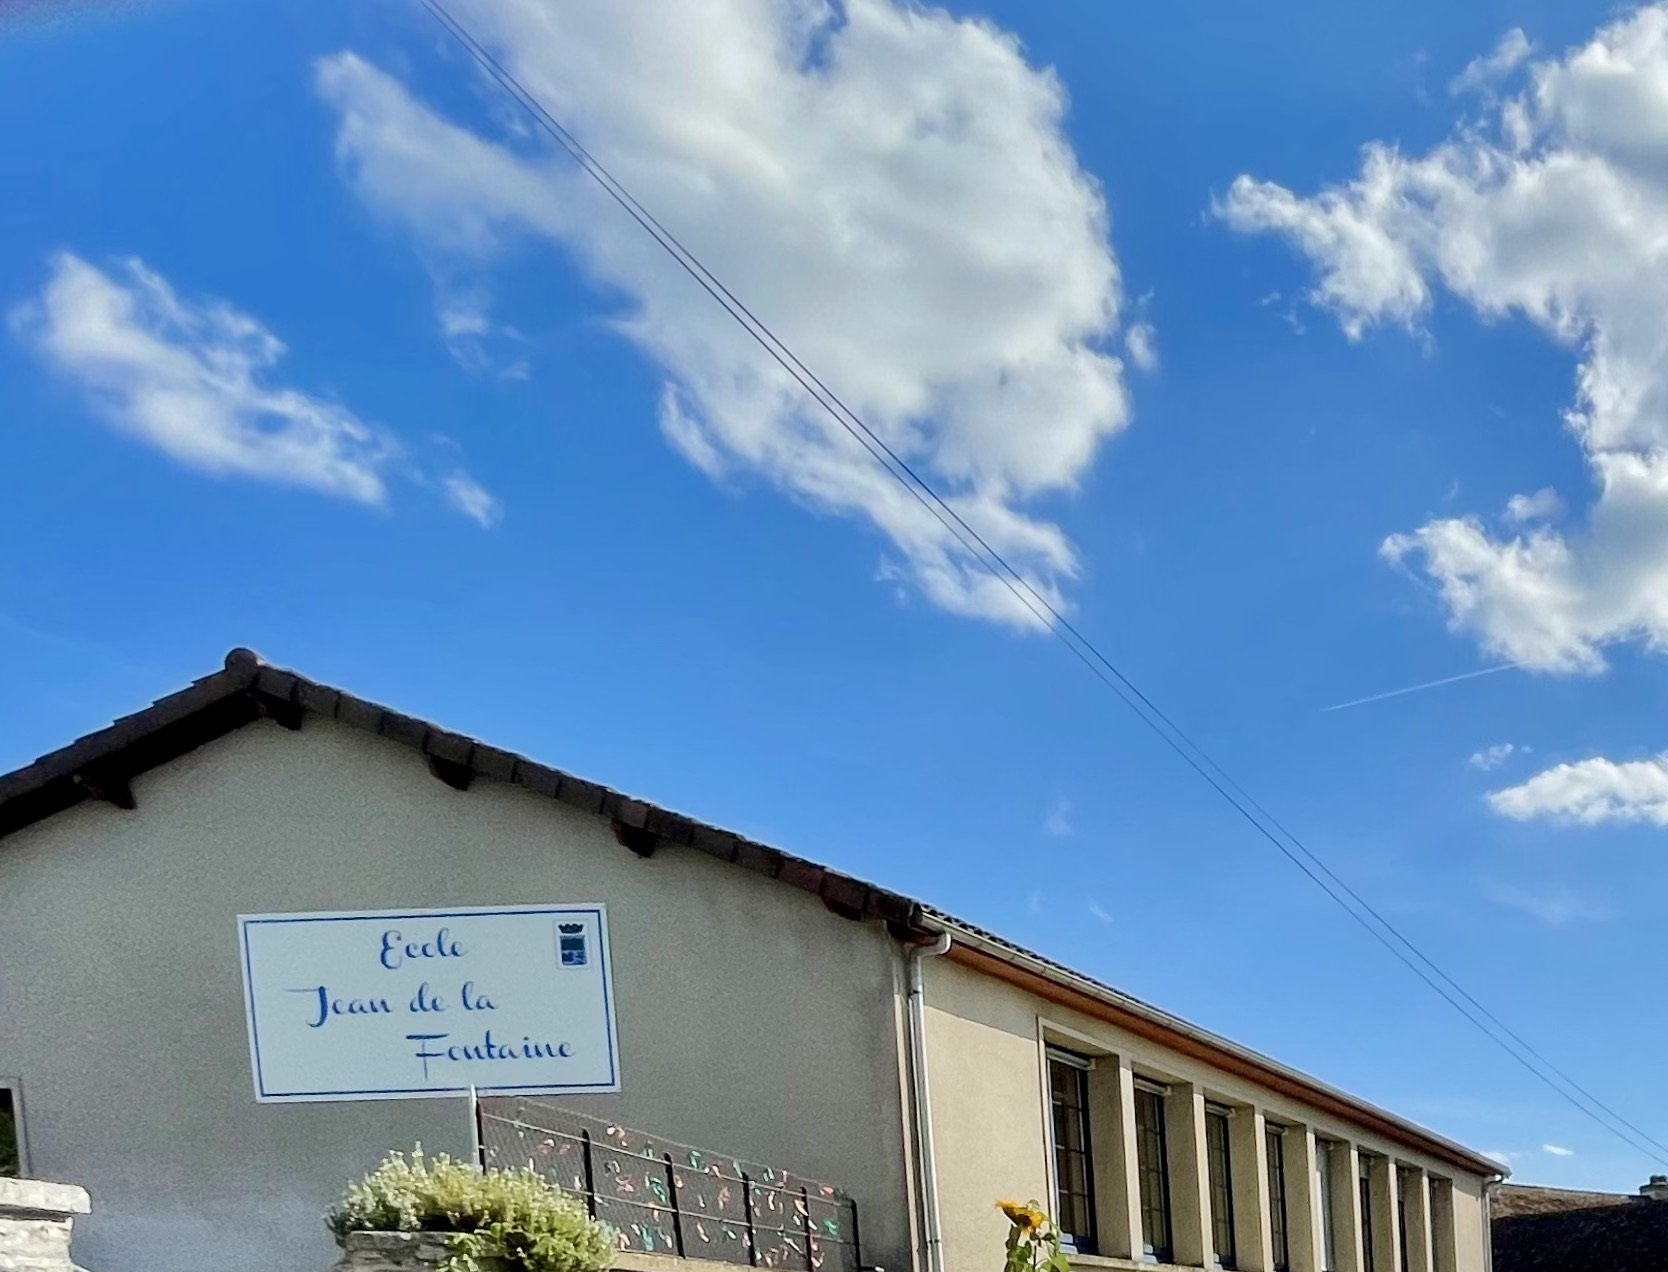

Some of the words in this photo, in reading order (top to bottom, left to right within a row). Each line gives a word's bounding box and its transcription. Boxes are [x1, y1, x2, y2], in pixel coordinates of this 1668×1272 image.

[380, 927, 467, 970] Ecole
[286, 985, 392, 1028] Jean
[409, 982, 448, 1013] de
[461, 981, 498, 1012] la
[405, 1030, 577, 1081] Fontaine
